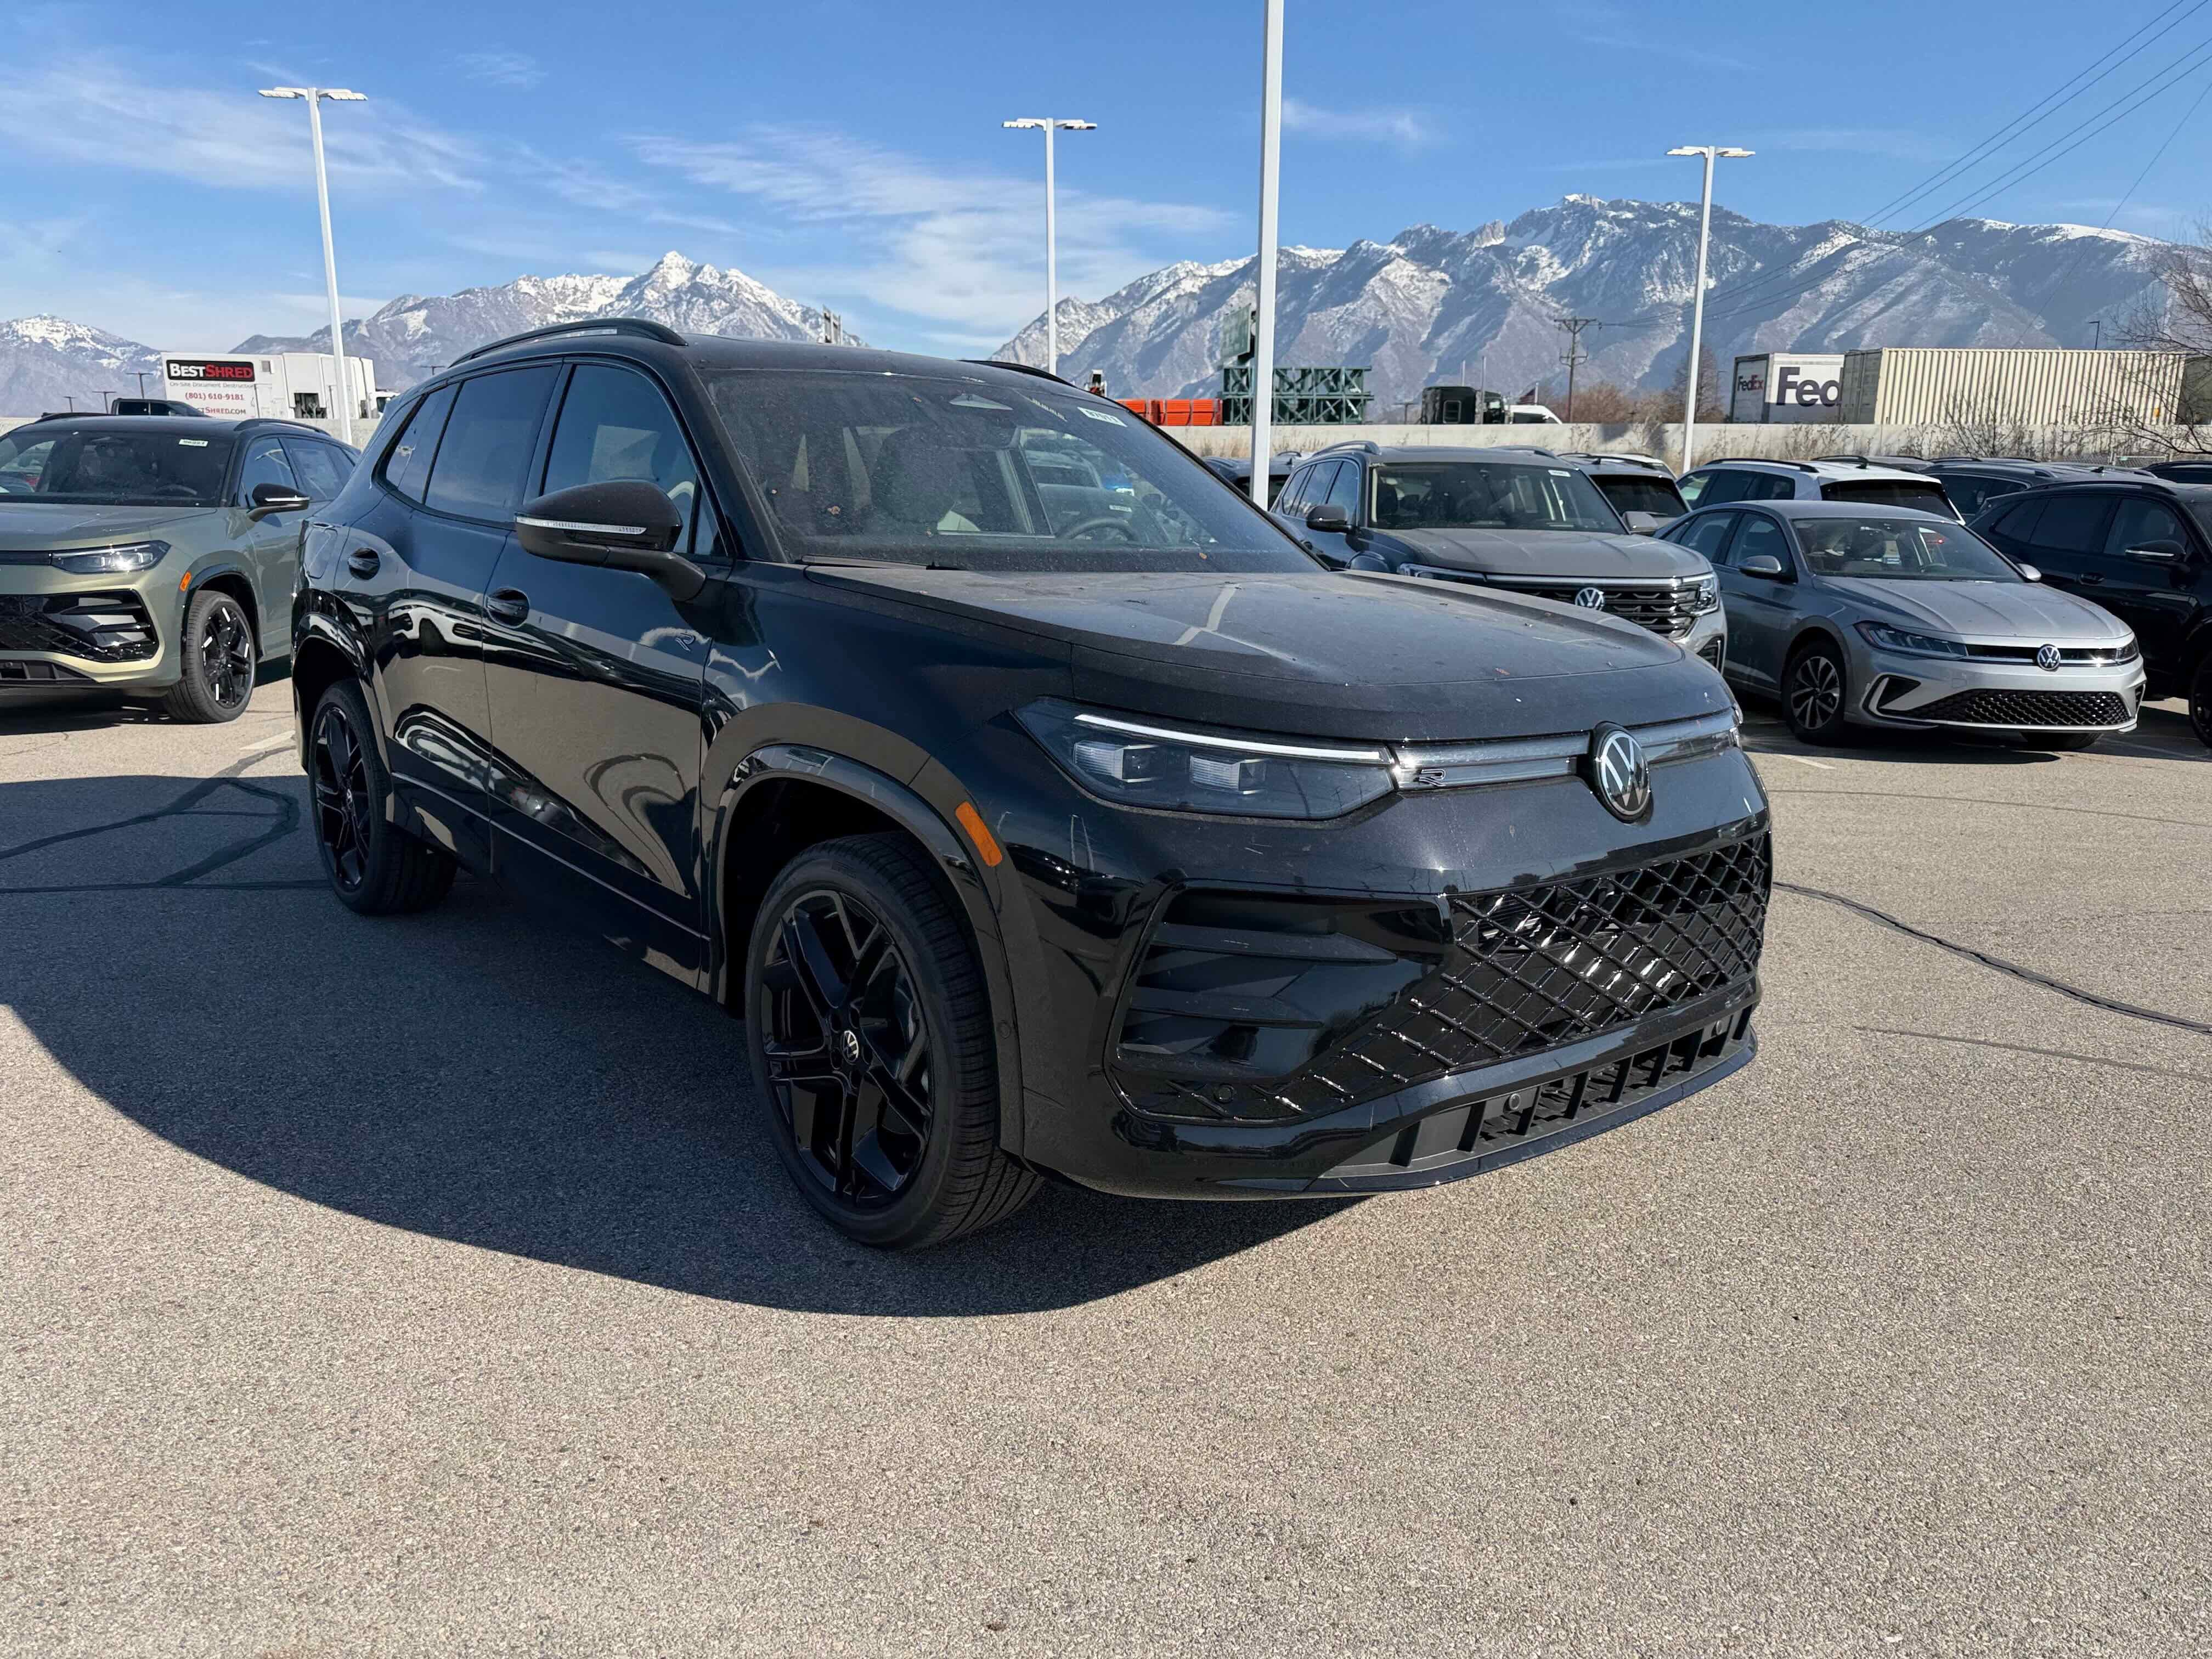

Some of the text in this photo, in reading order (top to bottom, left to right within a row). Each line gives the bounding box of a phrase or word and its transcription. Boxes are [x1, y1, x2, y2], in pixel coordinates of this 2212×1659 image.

[1737, 375, 1764, 391] FedEx
[185, 392, 244, 401] (801) 610-9181
[2037, 646, 2061, 670] VW
[1419, 769, 1447, 787] R
[1601, 732, 1648, 811] VW
